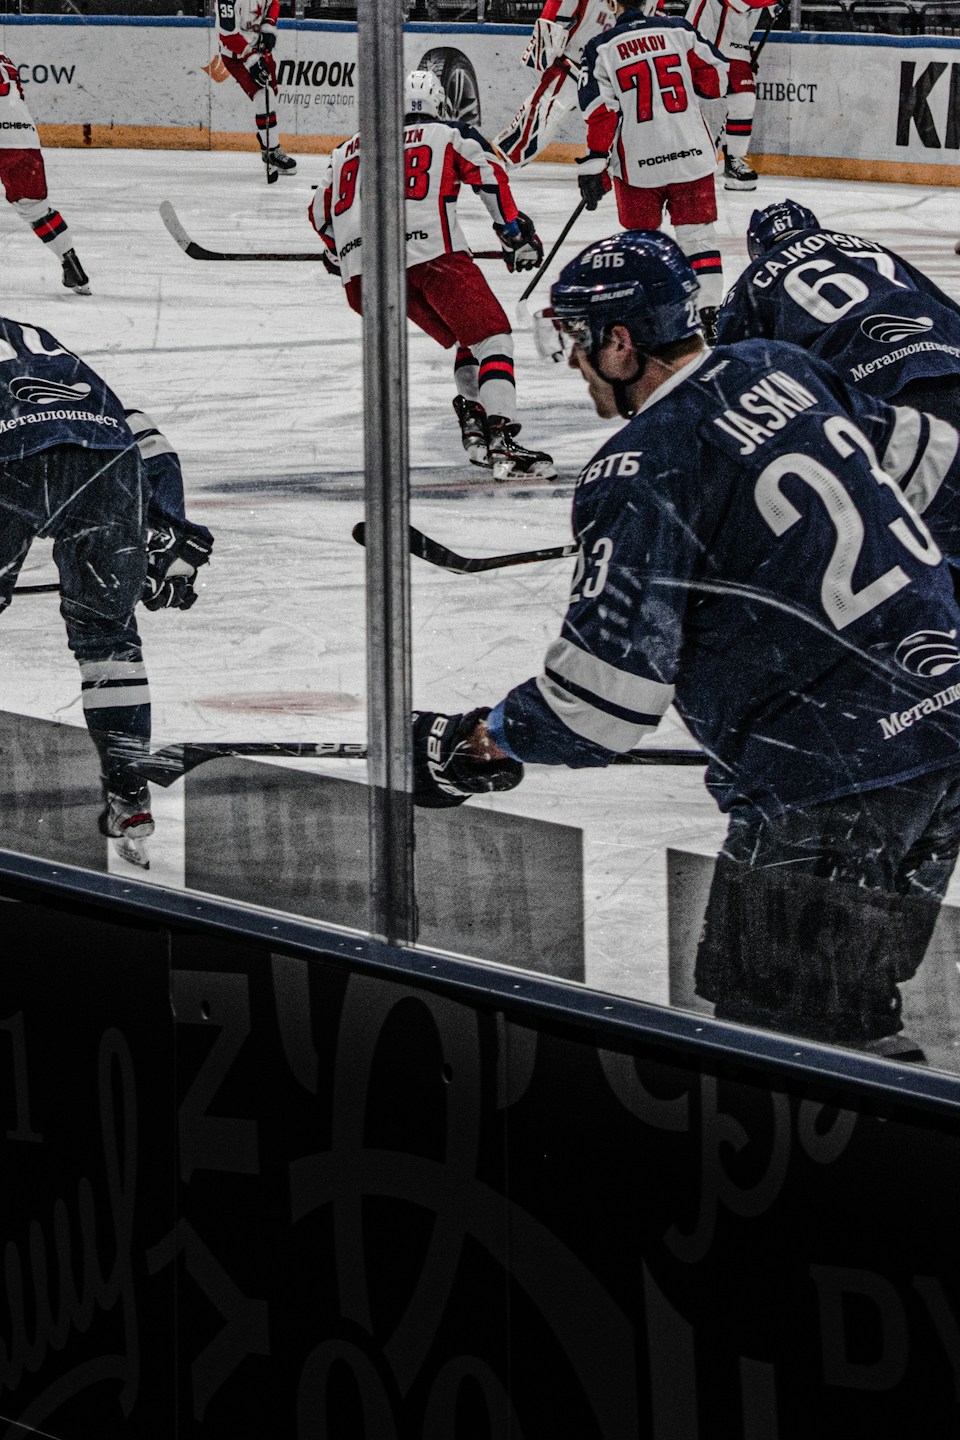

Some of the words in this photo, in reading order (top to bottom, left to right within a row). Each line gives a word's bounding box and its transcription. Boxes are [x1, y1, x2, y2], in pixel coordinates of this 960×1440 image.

[220, 4, 235, 18] 35
[616, 34, 666, 61] RYKOV
[616, 53, 688, 123] 75
[638, 148, 704, 168] РОСНЕФТЬ
[773, 216, 793, 232] 67
[592, 252, 625, 270] ВТБ
[783, 246, 910, 324] 67
[713, 369, 819, 457] JASKIN
[583, 451, 644, 485] ВТБ
[753, 414, 942, 632] 23
